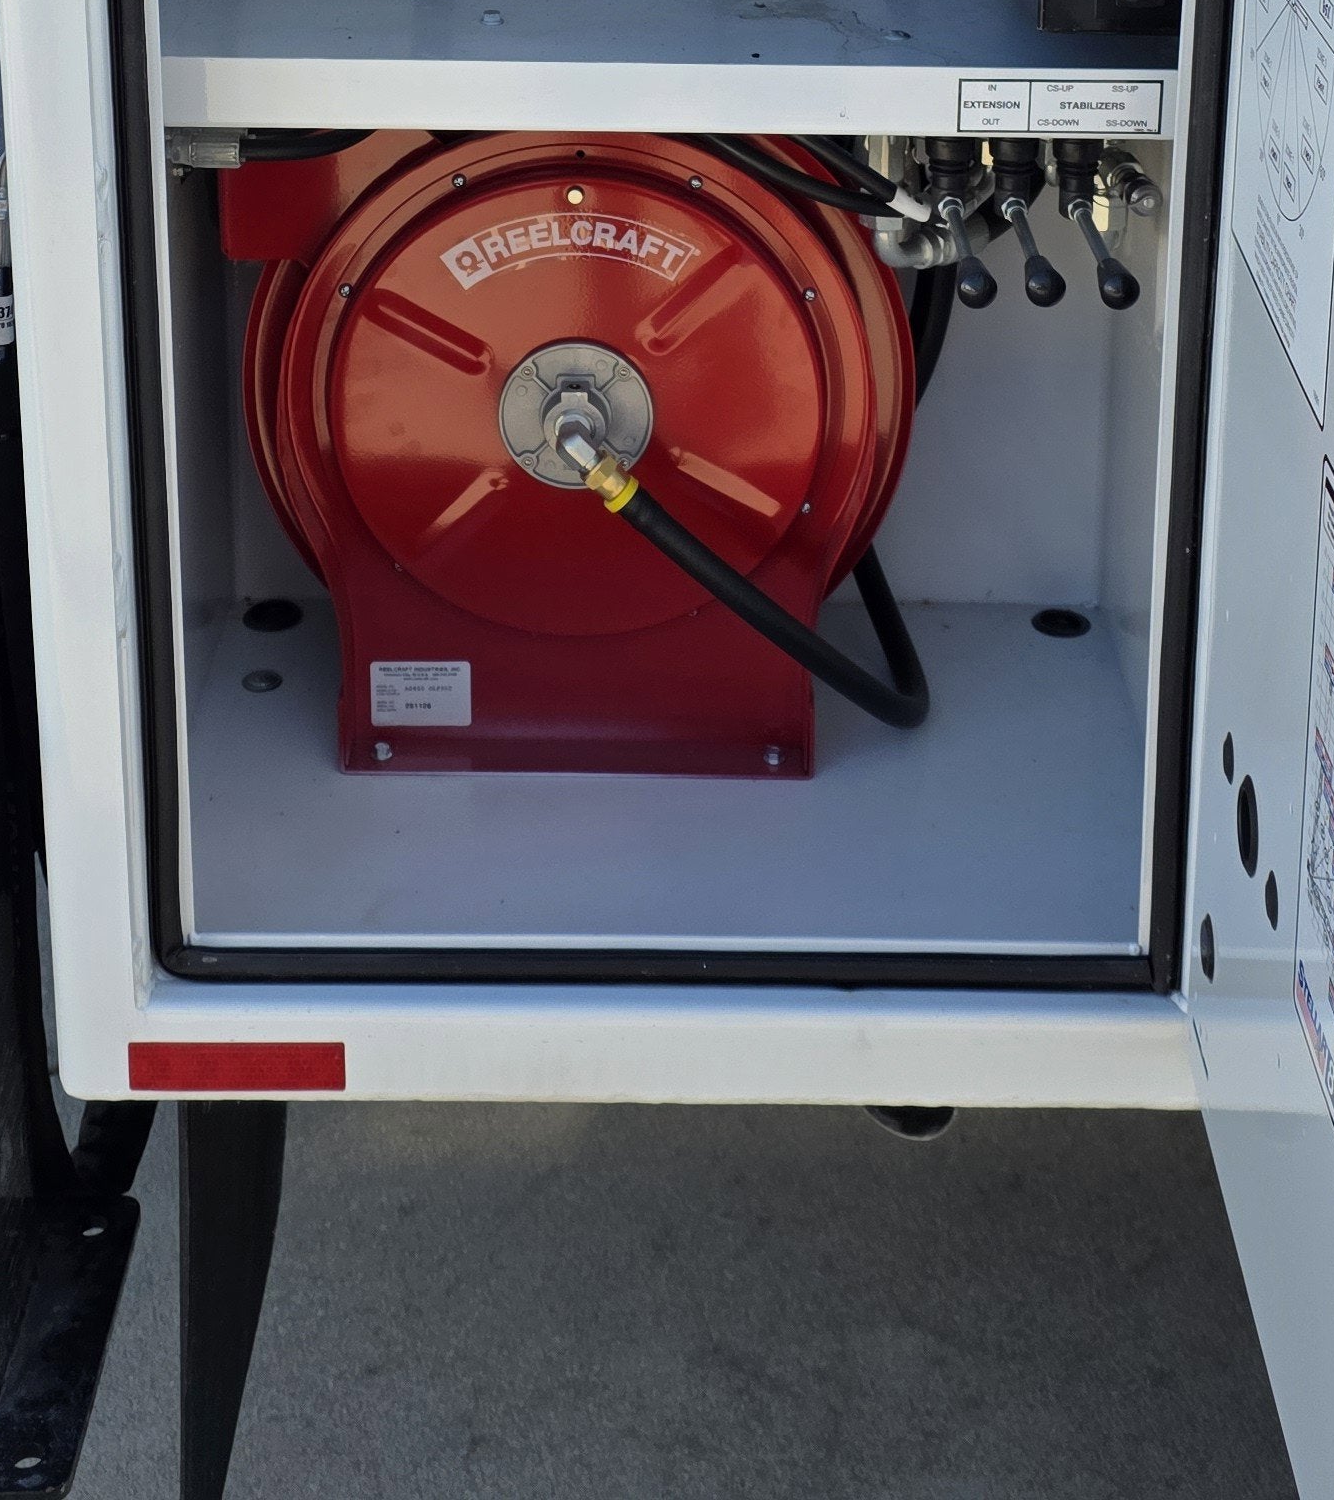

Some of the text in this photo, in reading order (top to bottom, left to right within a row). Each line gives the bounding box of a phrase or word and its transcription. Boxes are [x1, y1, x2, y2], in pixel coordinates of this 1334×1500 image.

[987, 84, 1139, 93] IN CS-UP SS-UP
[963, 100, 1126, 111] EXTENSION STABILIZERS
[981, 118, 1148, 128] OUT CS-DOWN SS-DOWN
[481, 221, 685, 270] REELCRAFT
